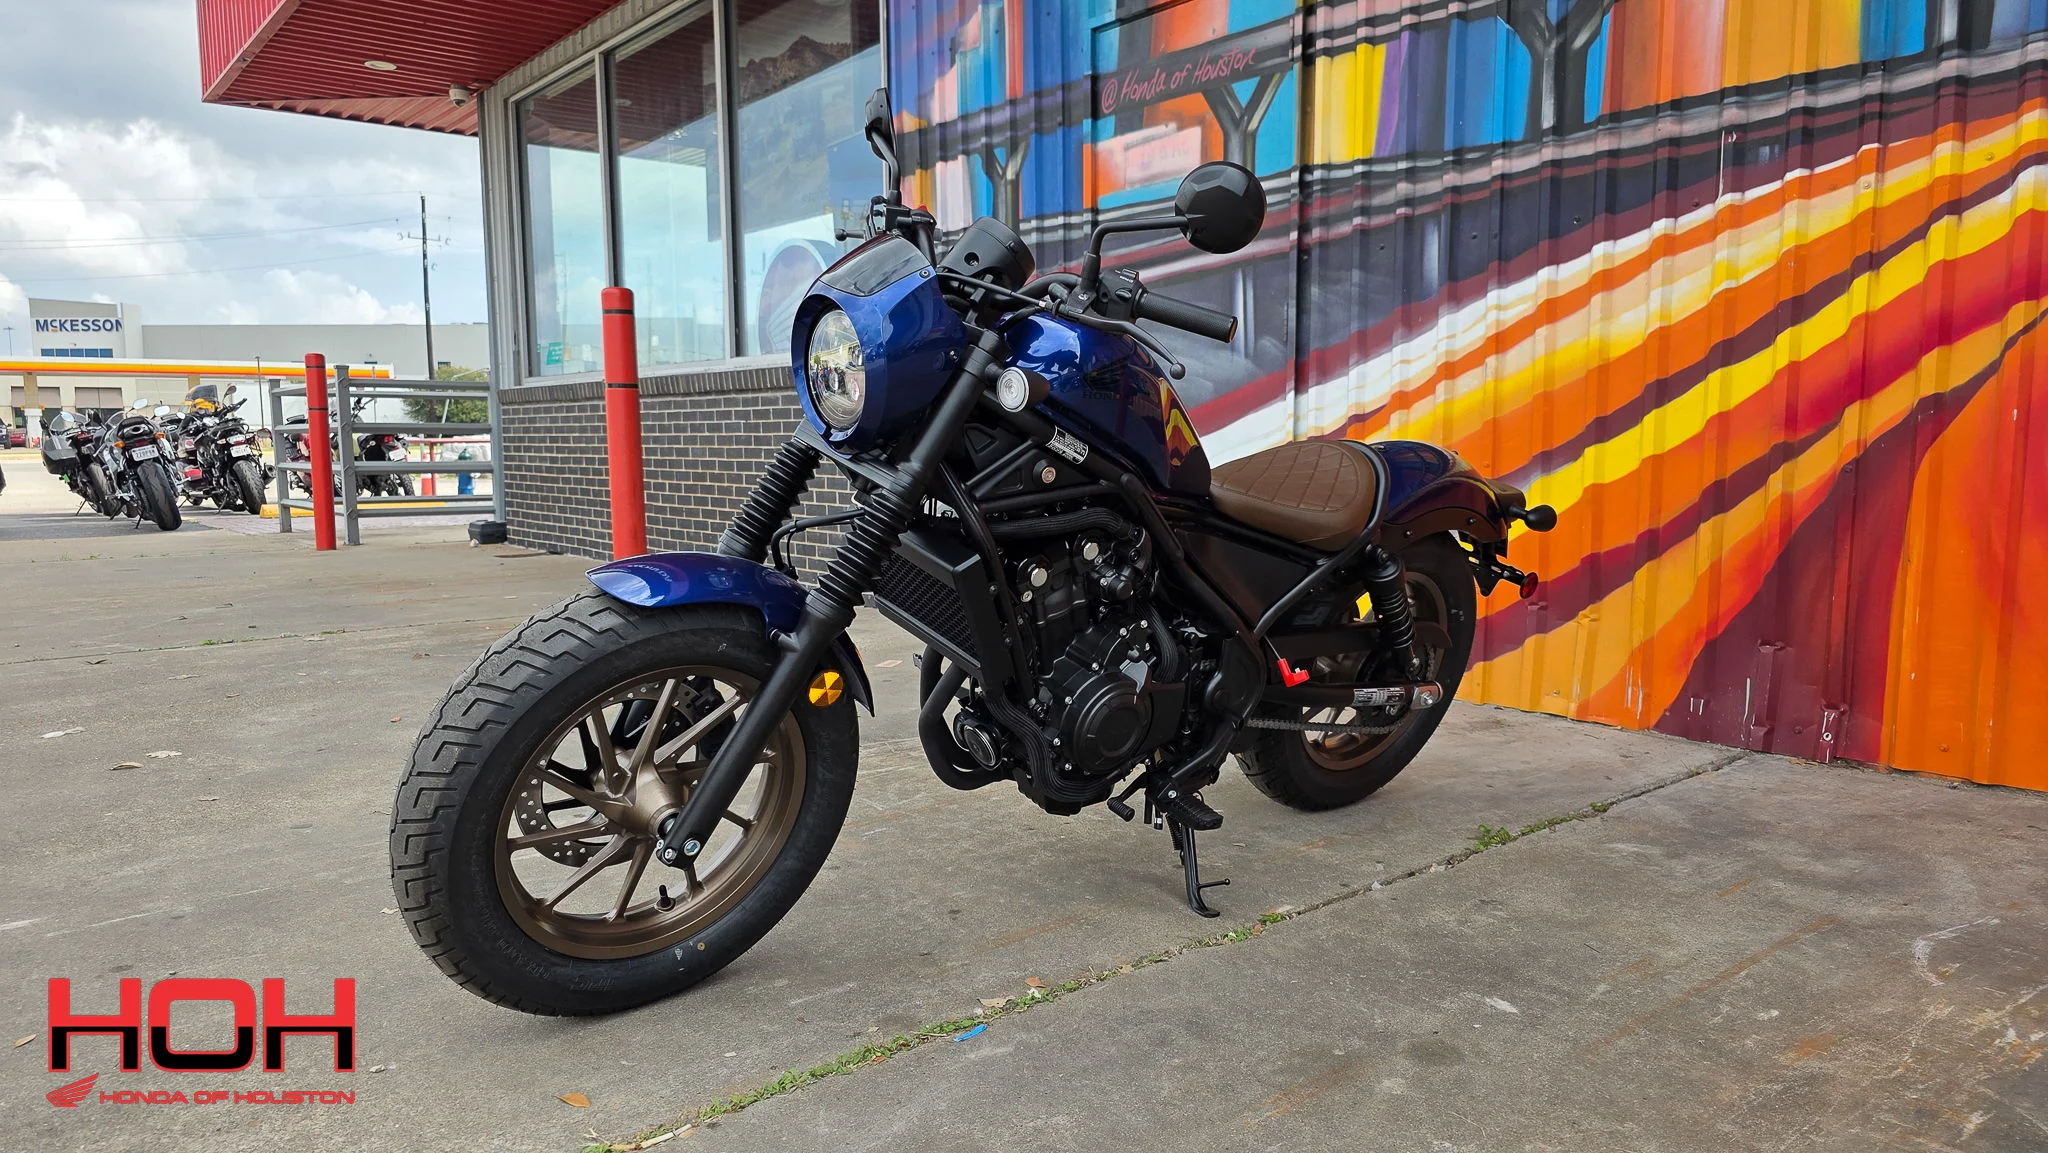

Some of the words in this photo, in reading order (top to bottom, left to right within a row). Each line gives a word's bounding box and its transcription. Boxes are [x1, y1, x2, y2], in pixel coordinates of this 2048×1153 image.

[1121, 68, 1166, 103] Honda
[1170, 64, 1192, 89] of
[1192, 46, 1256, 86] Houston
